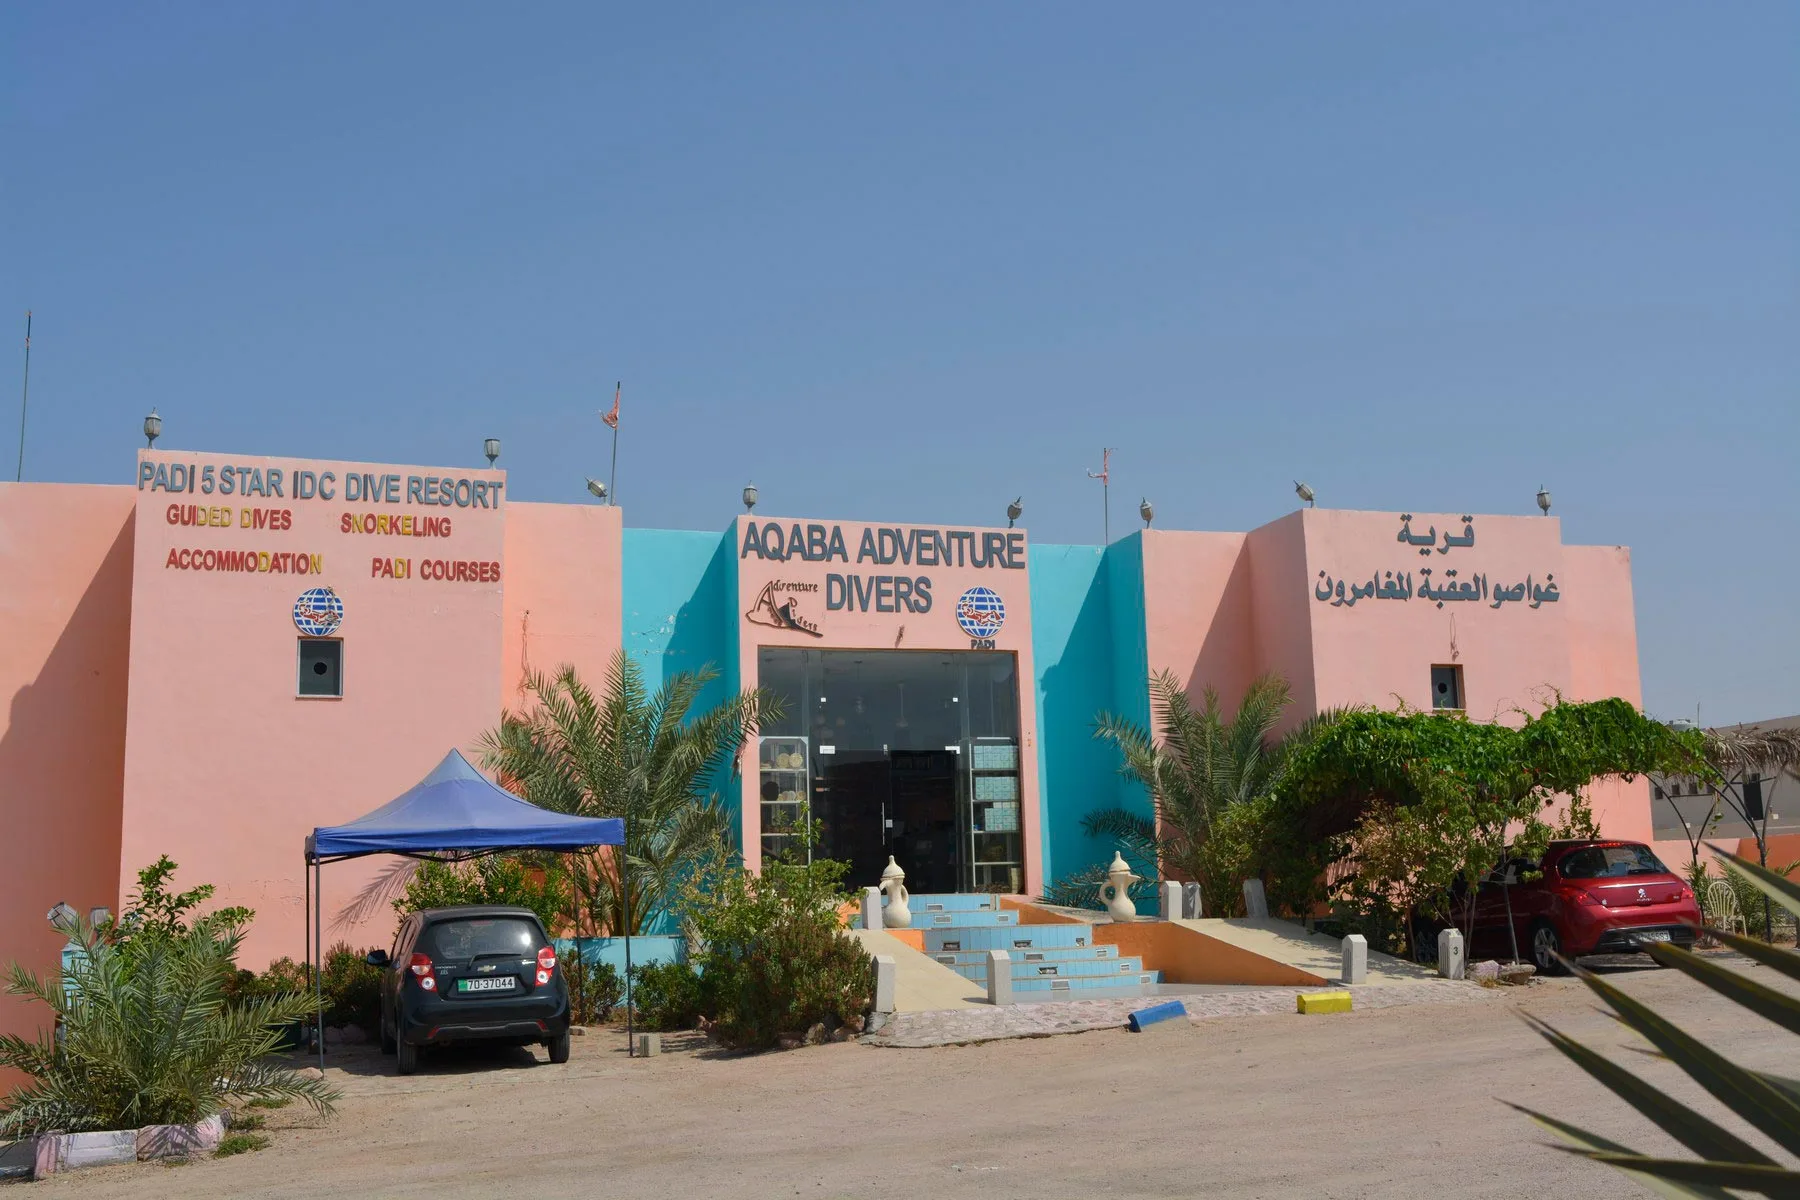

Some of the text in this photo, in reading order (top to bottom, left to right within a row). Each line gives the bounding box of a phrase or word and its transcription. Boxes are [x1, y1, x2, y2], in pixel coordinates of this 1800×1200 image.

[139, 461, 504, 509] PADI 5 STAR IDC DIVE RESORT
[166, 503, 292, 531] GUIDED DIVES
[340, 512, 452, 538] SNORKELING
[740, 521, 1026, 569] AQABA ADVENTURE
[1397, 513, 1475, 556] قرية
[166, 548, 322, 575] ACCOMMODATION
[372, 557, 501, 583] PADI COURSES
[826, 573, 933, 614] DIVERS
[1315, 567, 1560, 610] غواصو العقبة المغامرون
[1453, 946, 1459, 956] 3
